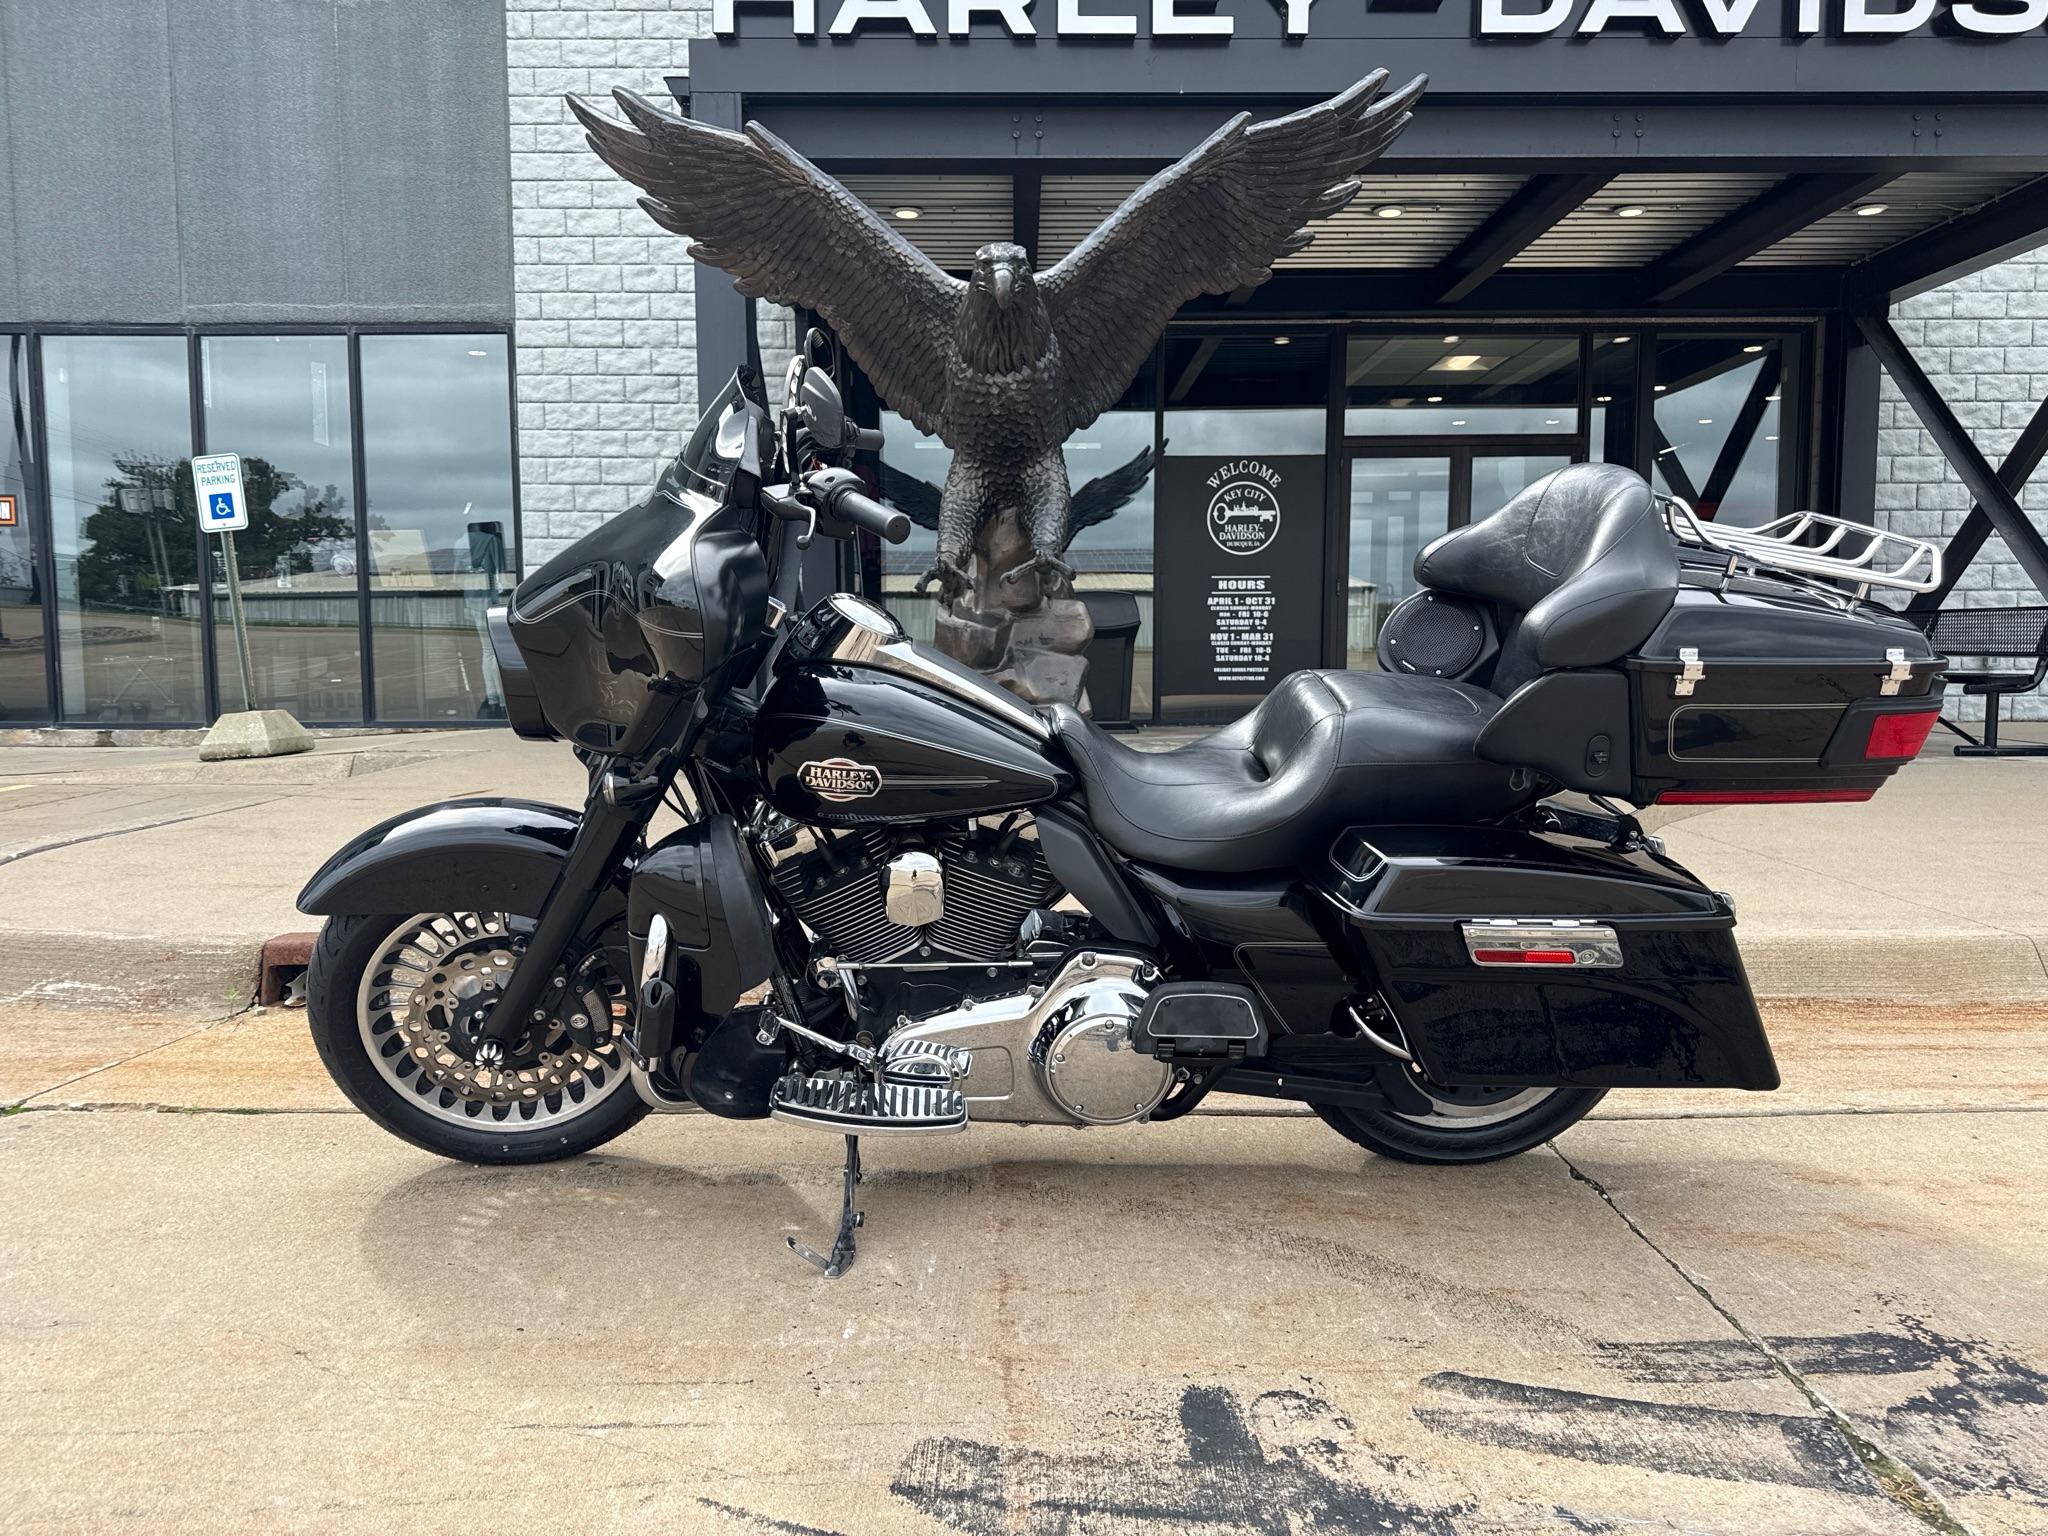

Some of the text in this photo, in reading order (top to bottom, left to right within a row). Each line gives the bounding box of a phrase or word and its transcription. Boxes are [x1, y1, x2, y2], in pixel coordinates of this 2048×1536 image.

[196, 461, 236, 473] RESERVED
[200, 474, 236, 486] PARKING
[1206, 460, 1282, 488] WELCOME
[1223, 488, 1267, 502] KEY CITY
[1224, 524, 1263, 533] HARLEY-
[1219, 531, 1265, 541] DAVIDSON
[1218, 580, 1266, 590] HOURS
[1207, 597, 1233, 605] APRIL
[1234, 597, 1239, 605] 1
[1245, 597, 1263, 605] OCT
[1264, 597, 1276, 605] 31
[1210, 633, 1229, 641] NOV
[1230, 633, 1235, 641] 1
[1241, 633, 1261, 641] MAR
[1262, 633, 1274, 641] 31
[810, 766, 871, 781] HARLEY-
[805, 776, 874, 790] DAVIDSON
